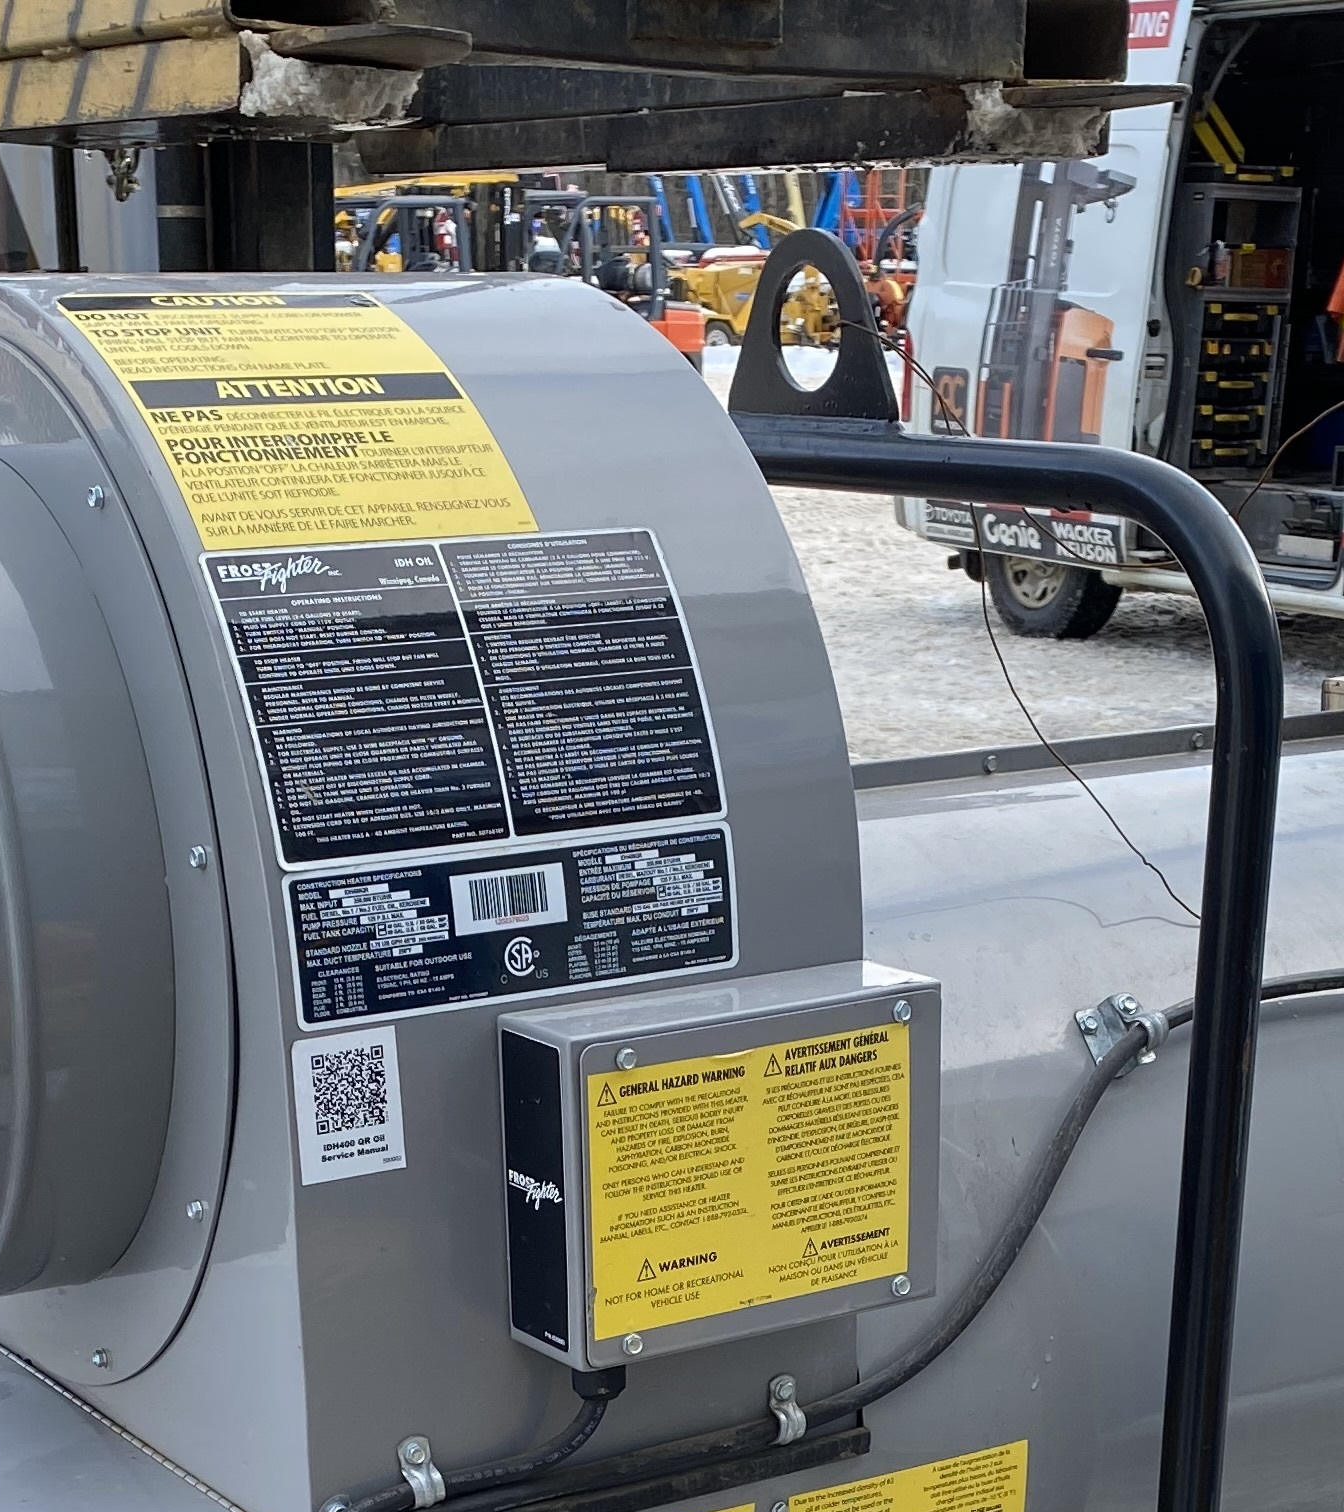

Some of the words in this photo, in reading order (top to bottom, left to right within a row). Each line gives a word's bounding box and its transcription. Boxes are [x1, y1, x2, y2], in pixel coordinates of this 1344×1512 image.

[150, 295, 287, 306] CAUTION
[73, 313, 106, 321] DO
[107, 312, 149, 320] NOT
[88, 329, 119, 338] TO
[120, 327, 171, 337] STOP
[174, 327, 222, 336] UNIT
[215, 376, 385, 399] ATTENTION
[149, 410, 181, 424] NE
[181, 409, 223, 422] PAS
[164, 436, 226, 452] POUR
[225, 431, 369, 448] INTERROMPRE
[368, 430, 394, 443] LE
[171, 444, 359, 465] FONCTIONNEMENT
[184, 477, 260, 490] VENTILATEUR
[259, 474, 333, 487] CONTINUERA
[331, 473, 349, 483] DE
[348, 470, 428, 482] FONCTIONNER
[428, 467, 472, 479] JUSQU'À
[471, 467, 486, 477] CE
[201, 511, 237, 523] AVANT
[238, 510, 256, 521] DE
[254, 508, 289, 520] VOUS
[288, 506, 327, 518] SERVIR
[326, 505, 343, 516] DE
[343, 504, 364, 515] CET
[367, 502, 416, 514] APPAREIL
[415, 498, 481, 511] RENSEIGNEZ
[479, 497, 511, 508] VOUS
[935, 507, 973, 525] TOYOTA
[982, 513, 1042, 550] Genie
[1052, 521, 1113, 546] WACKER
[1056, 543, 1117, 564] NEUSON
[784, 1037, 851, 1061] AVERTISSEMENT
[852, 1030, 889, 1048] GÉNÉRAL
[784, 1060, 817, 1077] RELATIF
[818, 1056, 837, 1071] AUX
[838, 1048, 877, 1067] DANGERS
[619, 1079, 659, 1098] GENERAL
[661, 1073, 699, 1090] HAZARD
[701, 1065, 745, 1083] WARNING
[321, 1151, 355, 1162] Service
[358, 1144, 388, 1157] Manual
[358, 1137, 371, 1146] QR
[509, 1169, 534, 1188] FROST
[526, 1180, 562, 1211] Fighter
[819, 1226, 890, 1250] AVERTISSEMENT
[658, 1251, 717, 1272] WARNING
[768, 1263, 787, 1274] NON
[788, 1256, 816, 1270] CONÇU
[817, 1252, 836, 1263] POUR
[837, 1242, 883, 1259] L'UTILISATION
[883, 1239, 889, 1249] À
[890, 1239, 899, 1247] LA
[778, 1269, 809, 1283] MAISON
[810, 1266, 822, 1276] OU
[823, 1261, 843, 1273] DANS
[844, 1259, 856, 1268] UN
[856, 1251, 888, 1265] VÉHICULE
[604, 1294, 623, 1306] NOT
[625, 1290, 642, 1302] FOR
[643, 1284, 670, 1298] HOME
[671, 1281, 684, 1292] OR
[686, 1268, 744, 1289] RECREATIONAL
[810, 1277, 819, 1286] DE
[820, 1268, 857, 1284] PLAISANCE
[650, 1294, 682, 1308] VEHICLE
[684, 1290, 700, 1302] USE
